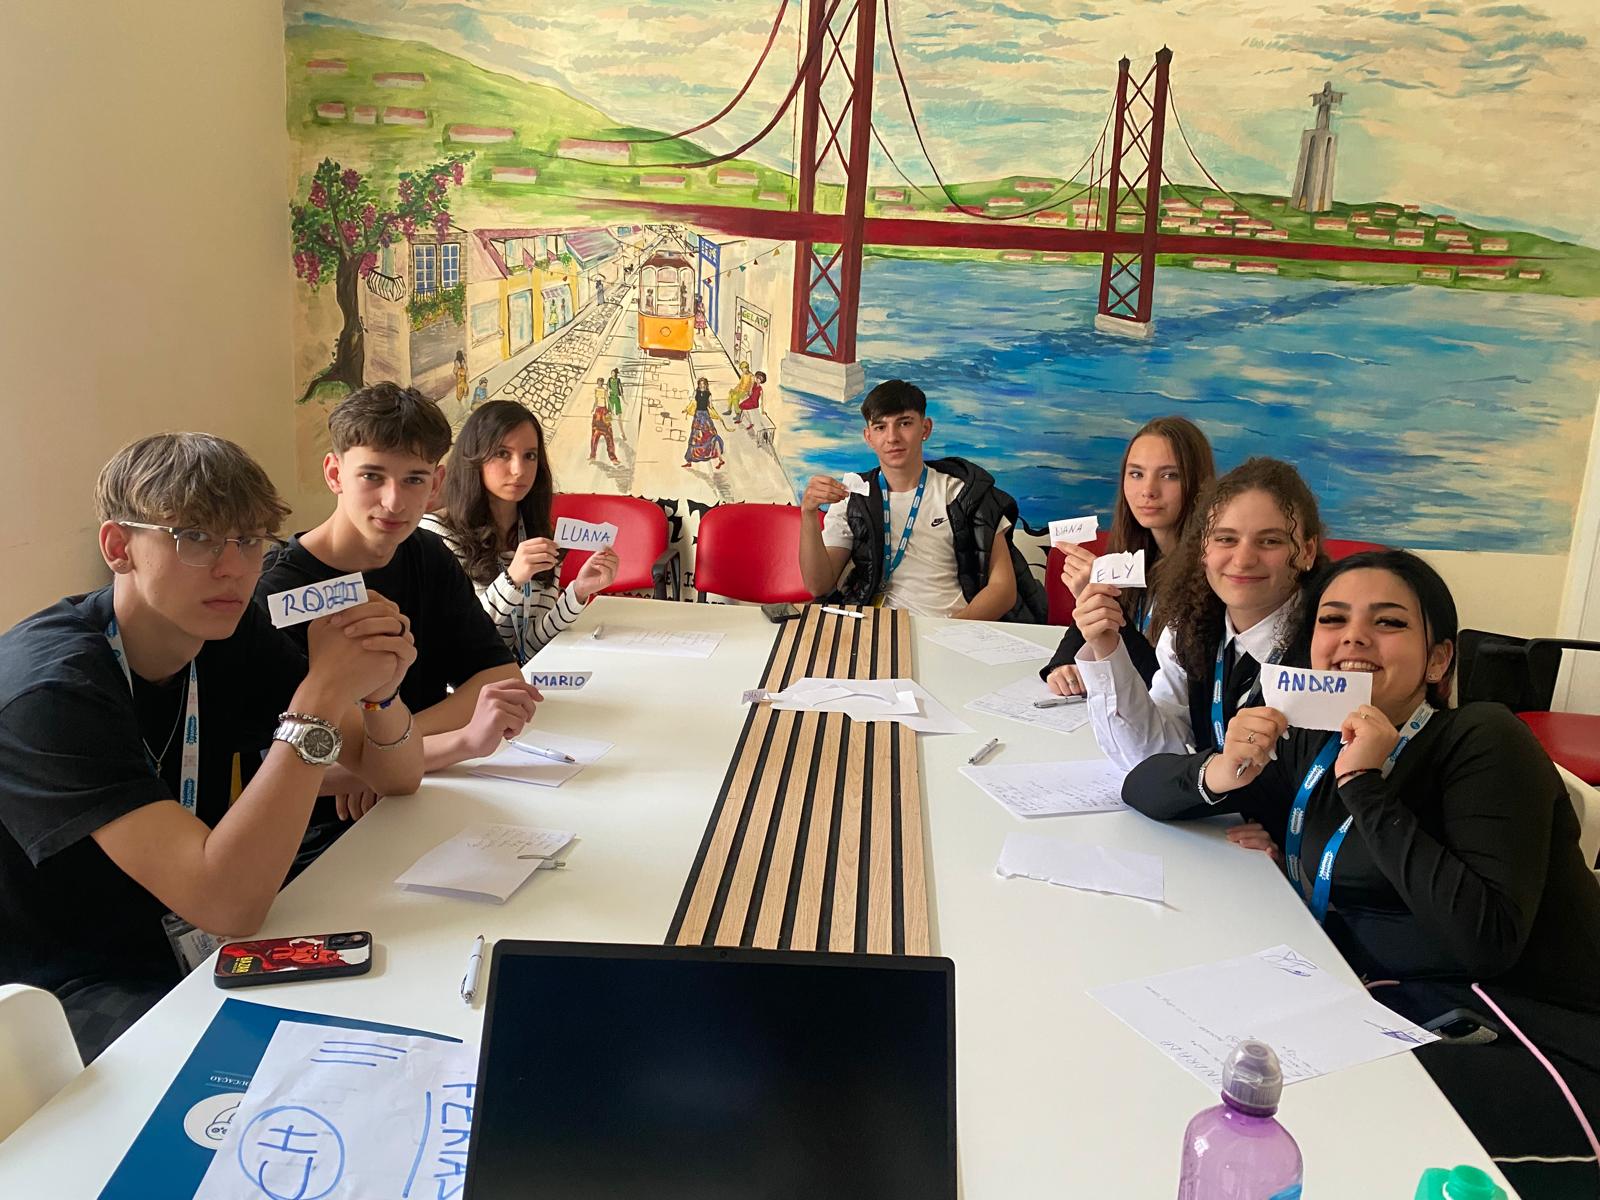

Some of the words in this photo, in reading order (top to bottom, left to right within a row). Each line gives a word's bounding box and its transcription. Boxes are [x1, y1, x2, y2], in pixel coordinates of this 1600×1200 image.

[742, 310, 769, 328] GELATO
[561, 523, 610, 542] LUANA
[1096, 564, 1134, 583] ELY
[533, 674, 586, 687] MARIO
[1278, 671, 1348, 695] ANDRA
